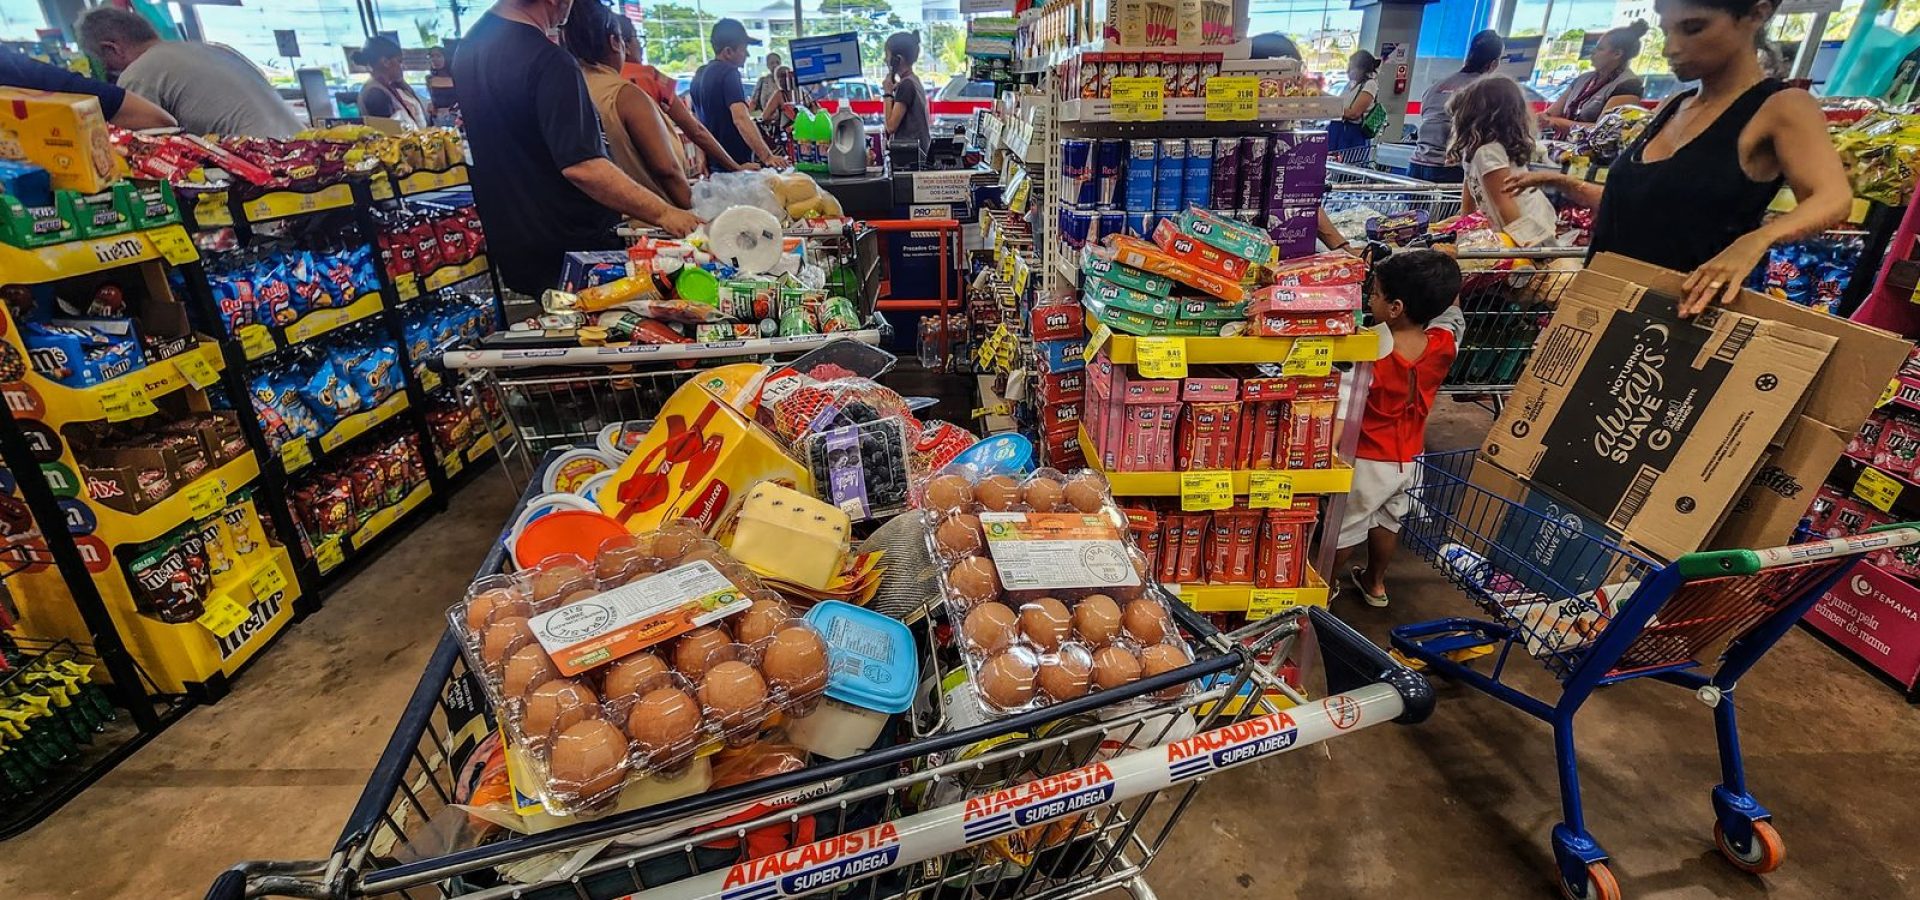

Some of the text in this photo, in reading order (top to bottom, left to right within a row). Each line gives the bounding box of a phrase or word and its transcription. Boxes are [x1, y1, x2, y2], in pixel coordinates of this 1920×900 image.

[1274, 166, 1285, 200] Red Bull
[1175, 240, 1193, 253] fini
[1091, 259, 1112, 272] fini
[1100, 286, 1118, 298] fini
[1046, 313, 1069, 326] fini
[1186, 301, 1206, 312] fini
[1063, 342, 1084, 356] fini
[1060, 375, 1080, 388] fini
[1609, 343, 1645, 396] NOTURNO
[1057, 405, 1077, 419] fini
[1594, 347, 1668, 458] always
[1511, 419, 1531, 440] G
[1611, 395, 1664, 464] SUAVE
[1647, 428, 1673, 451] G
[1087, 546, 1118, 561] BRASIL
[1558, 597, 1598, 619] Ades
[1828, 594, 1859, 618] junto
[1857, 610, 1880, 631] pela
[1872, 589, 1918, 622] FEMAMA
[557, 615, 607, 638] BRASIL
[1815, 602, 1892, 657] câncer de mama
[1168, 711, 1297, 763] ATACADISTA
[1220, 733, 1292, 766] SUPER ADEGA
[963, 762, 1115, 823] ATACADISTA
[1025, 789, 1106, 825] SUPER ADEGA
[722, 821, 899, 892] ATACADISTA
[794, 854, 890, 893] SUPER ADEGA
